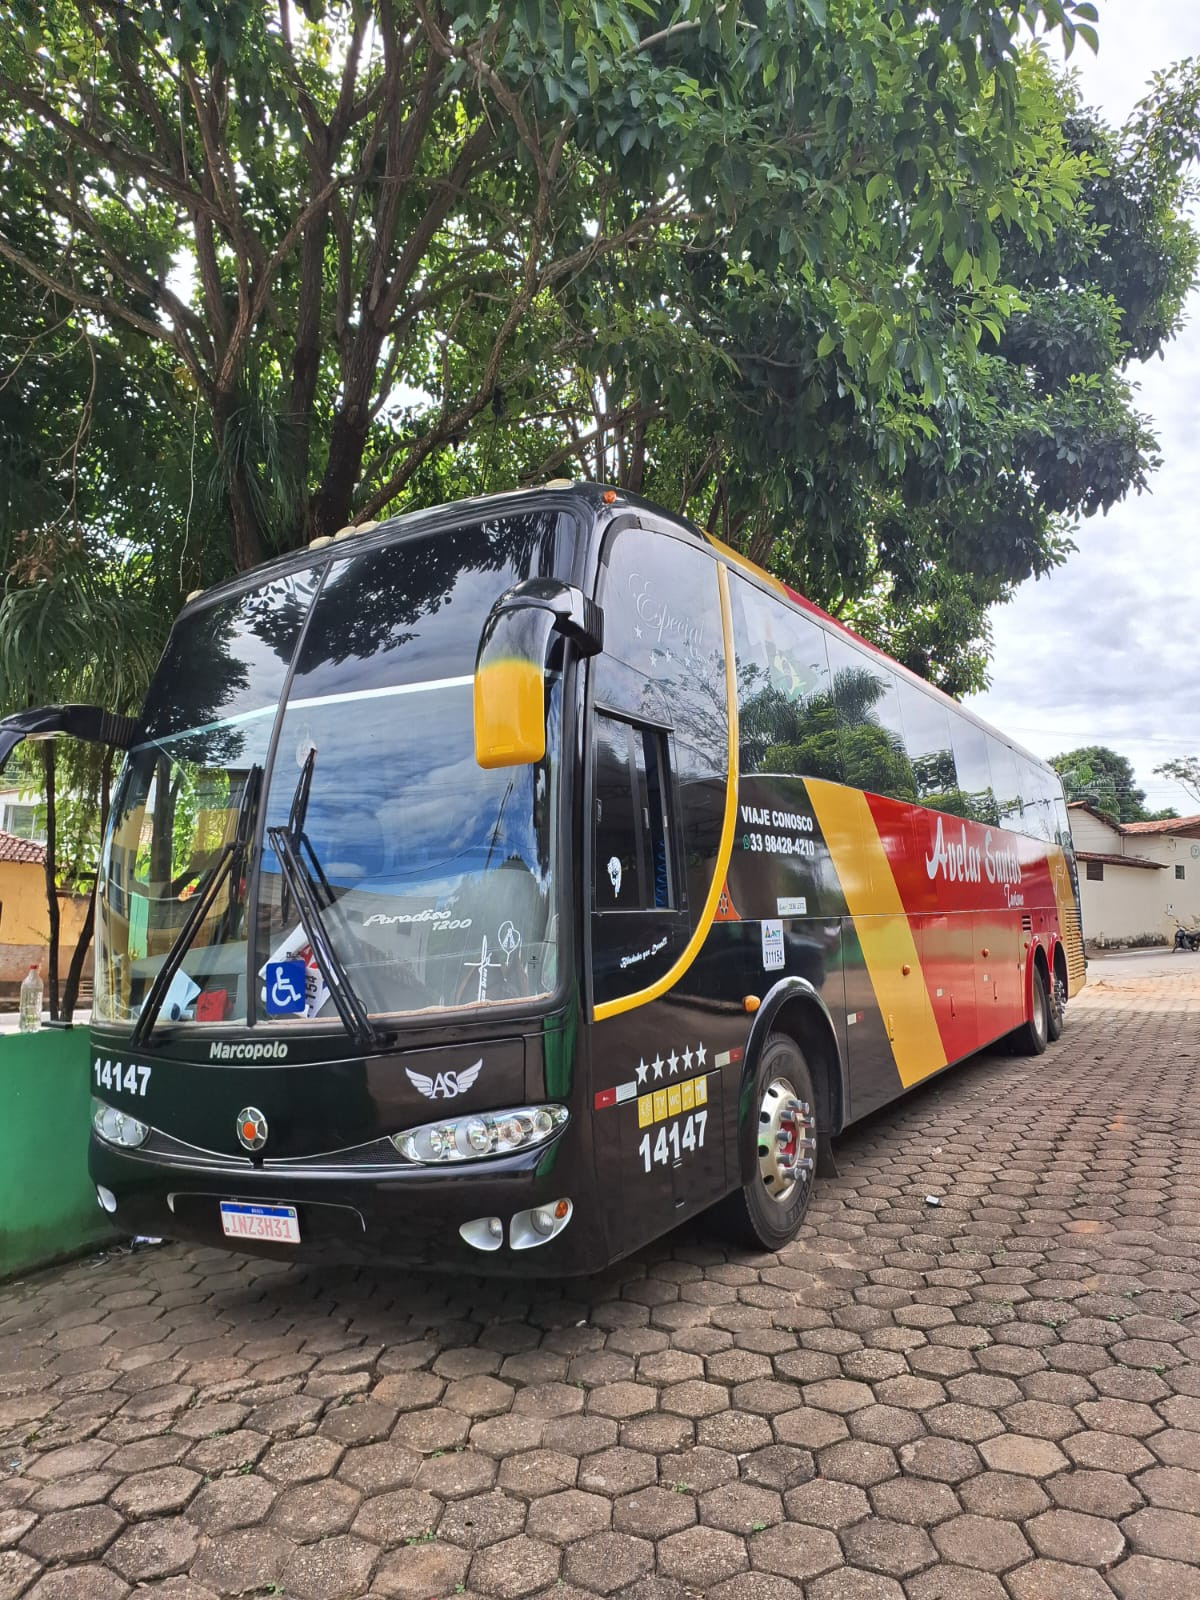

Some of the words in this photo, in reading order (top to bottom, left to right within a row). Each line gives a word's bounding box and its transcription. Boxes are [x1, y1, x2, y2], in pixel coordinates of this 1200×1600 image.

[741, 805, 771, 826] VIAJE
[772, 810, 813, 832] CONOSCO
[750, 832, 763, 852] 33
[764, 834, 815, 856] 98428-4210
[363, 909, 452, 927] Paradiso
[432, 918, 472, 931] 1200
[209, 1041, 288, 1060] Marcopolo
[94, 1057, 152, 1097] 14147
[429, 1070, 459, 1099] AS
[639, 1110, 708, 1173] 14147
[231, 1215, 292, 1239] INZ3H31
